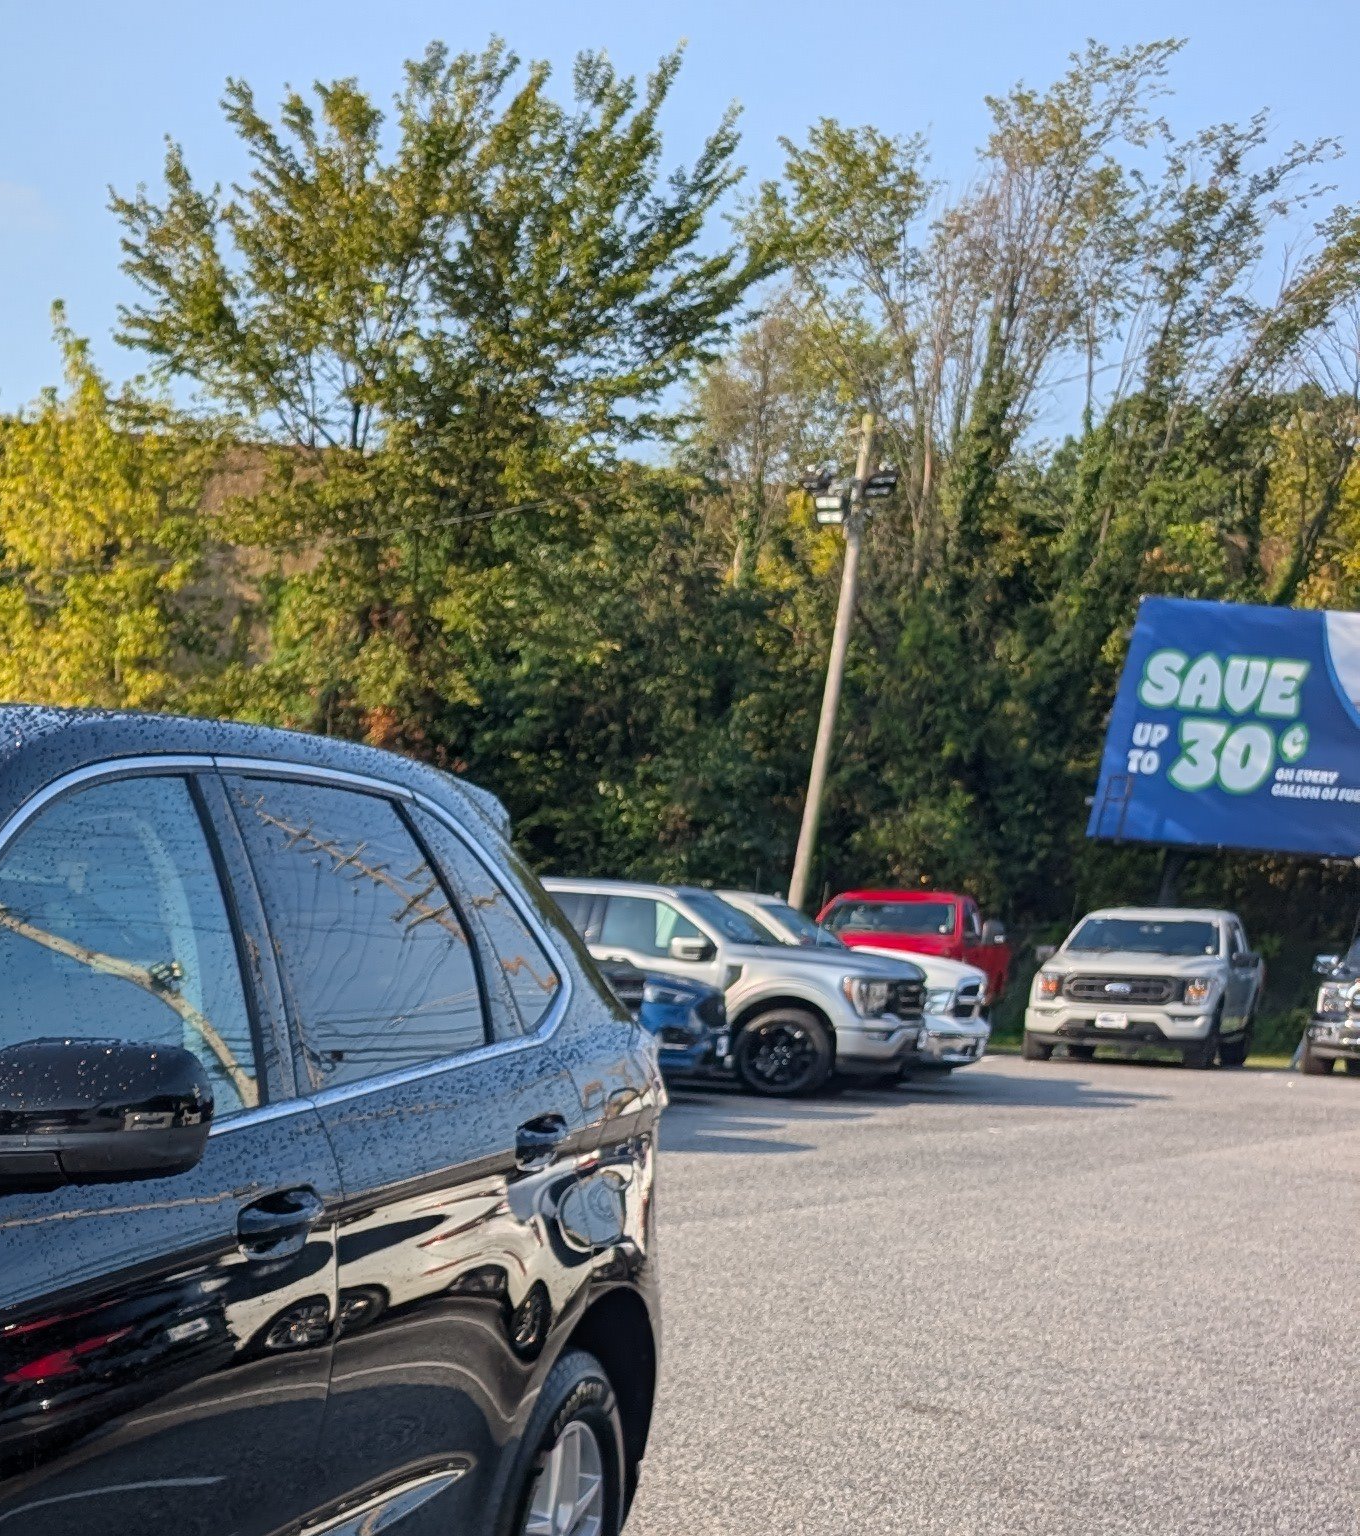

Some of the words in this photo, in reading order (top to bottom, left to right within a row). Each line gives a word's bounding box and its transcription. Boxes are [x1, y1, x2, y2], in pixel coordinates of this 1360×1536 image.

[1139, 650, 1310, 718] SAVE
[1132, 721, 1169, 748] UP
[1127, 750, 1160, 775] TO
[1275, 767, 1295, 782] ON
[1295, 769, 1339, 785] EVERY
[1271, 783, 1320, 799] GALLON
[1321, 787, 1338, 801] OF
